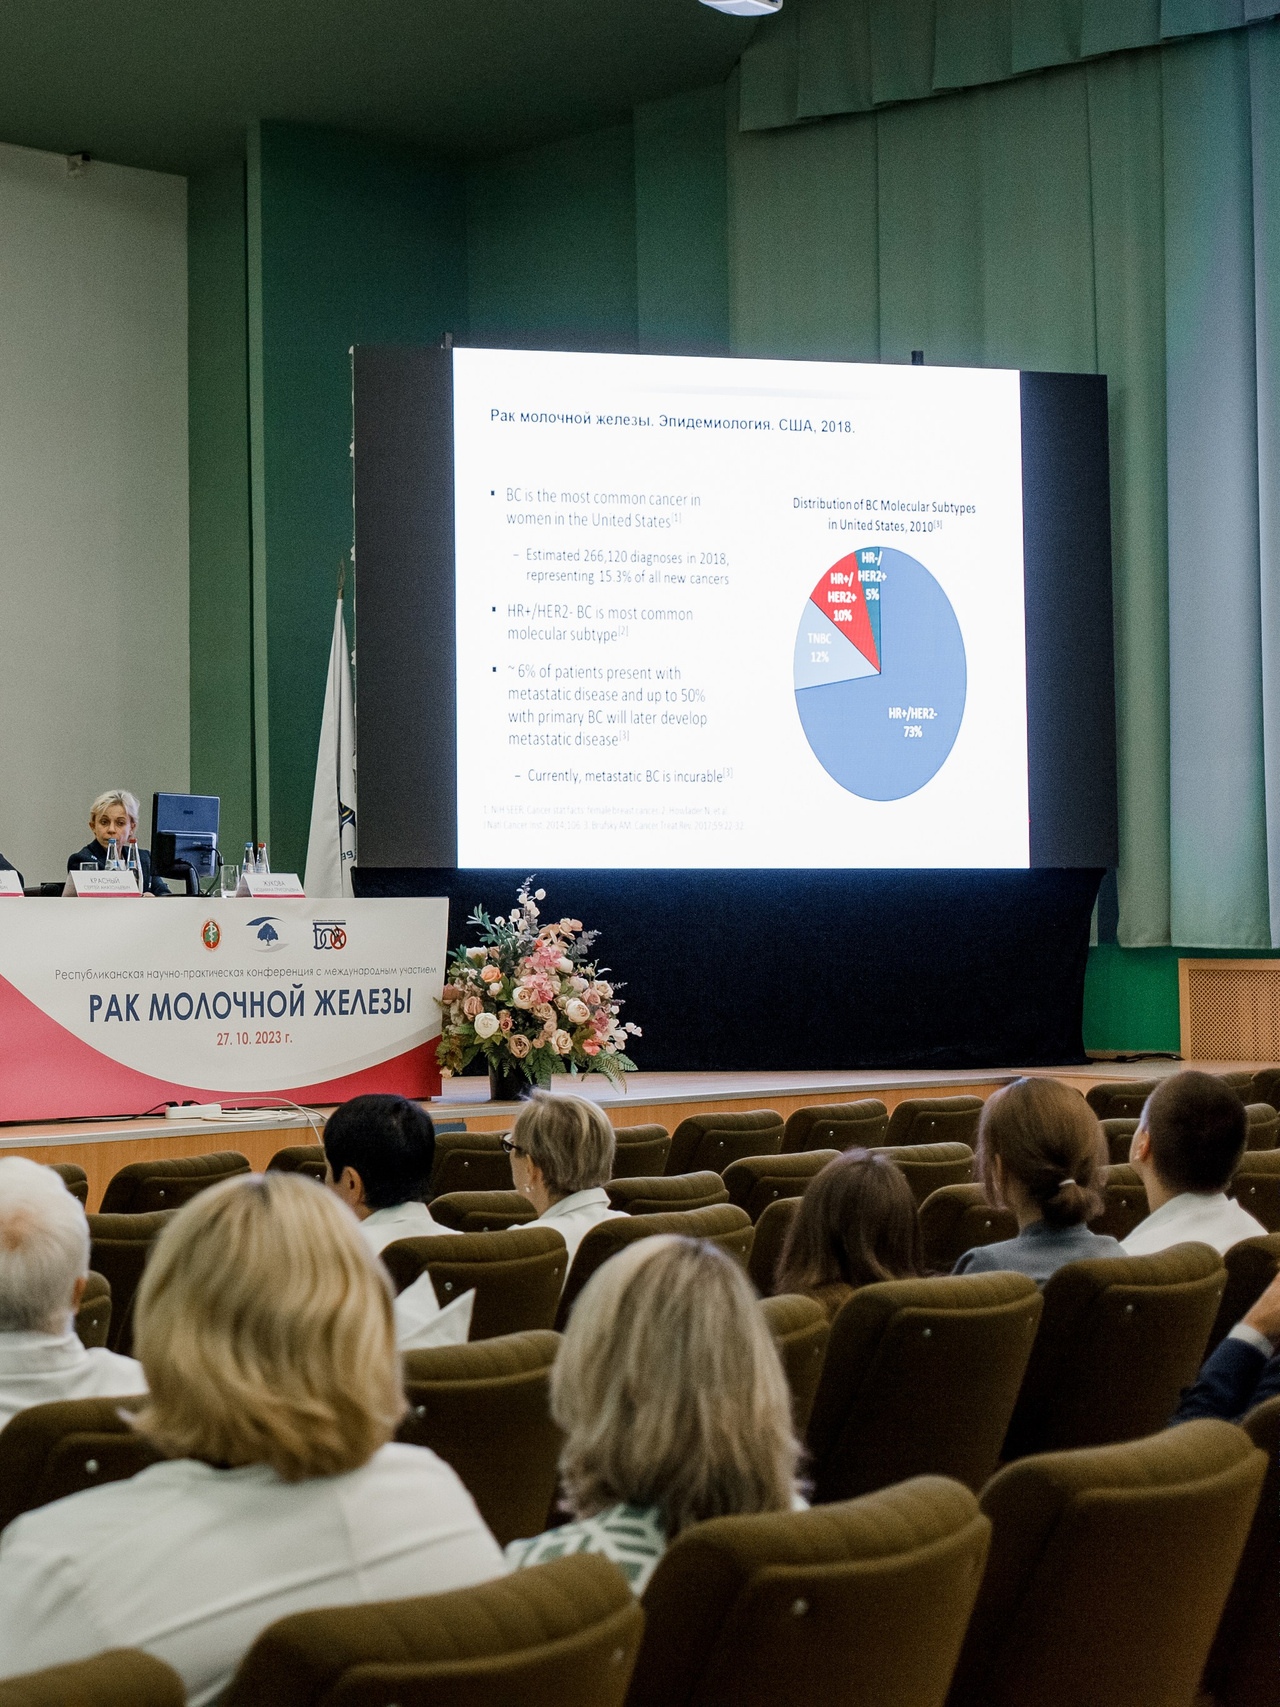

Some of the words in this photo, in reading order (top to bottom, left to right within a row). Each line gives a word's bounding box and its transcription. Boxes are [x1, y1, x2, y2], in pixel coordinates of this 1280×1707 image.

[490, 409, 515, 422] Рак
[520, 411, 591, 425] молочной
[596, 415, 654, 427] железы.
[659, 415, 774, 431] Эпидемиология.
[779, 419, 817, 434] США,
[821, 420, 855, 433] 2018.
[506, 488, 522, 501] BC
[525, 489, 533, 502] is
[537, 489, 556, 502] the
[561, 490, 590, 503] most
[593, 493, 646, 505] common
[649, 494, 686, 506] cancer
[691, 493, 701, 506] in
[793, 497, 852, 510] Distribution
[854, 499, 864, 510] of
[866, 500, 879, 511] BC
[881, 500, 930, 513] Molecular
[932, 501, 976, 516] Subtypes
[507, 513, 551, 525] women
[555, 512, 564, 525] in
[569, 512, 588, 526] the
[592, 513, 631, 527] United
[828, 518, 838, 530] in
[840, 518, 873, 531] United
[875, 520, 908, 534] States,
[526, 548, 580, 561] Estimated
[583, 550, 627, 564] 266,120
[630, 550, 683, 566] diagnoses
[687, 552, 696, 564] in
[700, 552, 730, 566] 2018,
[861, 551, 883, 566] HR-/
[527, 569, 594, 585] representing
[600, 570, 631, 583] 15.3%
[635, 570, 646, 583] of
[649, 571, 661, 583] all
[664, 574, 686, 584] new
[690, 574, 729, 585] cancers
[830, 572, 854, 587] HR+/
[858, 570, 887, 582] HER2+
[827, 590, 857, 603] HER2+
[865, 588, 880, 601] 5%
[508, 603, 573, 620] HR+/HER2-
[577, 605, 592, 619] BC
[596, 606, 604, 619] is
[608, 607, 637, 620] most
[641, 608, 693, 621] common
[833, 609, 853, 622] 10%
[508, 626, 567, 640] molecular
[808, 633, 832, 645] TNBC
[810, 651, 830, 663] 12%
[539, 663, 552, 678] of
[555, 665, 603, 681] patients
[607, 667, 652, 682] present
[656, 666, 681, 680] with
[508, 687, 571, 701] metastatic
[575, 687, 618, 702] disease
[621, 687, 643, 702] and
[647, 690, 661, 705] up
[666, 689, 677, 702] to
[681, 688, 706, 703] 50%
[508, 709, 534, 723] with
[538, 709, 584, 726] primary
[588, 710, 603, 724] BC
[607, 709, 627, 724] will
[630, 710, 657, 725] later
[661, 710, 708, 728] develop
[888, 706, 938, 722] HR+/HER2-
[509, 732, 572, 746] metastatic
[903, 725, 923, 738] 73%
[528, 769, 582, 784] Currently,
[585, 769, 642, 782] metastatic
[646, 770, 660, 782] BC
[663, 770, 671, 782] is
[55, 969, 144, 981] Республиканская
[147, 968, 244, 980] научно-практическая
[246, 967, 313, 978] конференция
[316, 968, 321, 976] с
[324, 966, 397, 976] международным
[399, 966, 437, 975] участием
[89, 993, 140, 1023] РАК
[149, 983, 305, 1021] МОЛОЧНОЙ
[314, 988, 412, 1016] ЖЕЛЕЗЫ
[216, 1033, 232, 1046] 27.
[236, 1032, 252, 1045] 10.
[256, 1031, 282, 1045] 2023
[285, 1033, 293, 1044] г.
